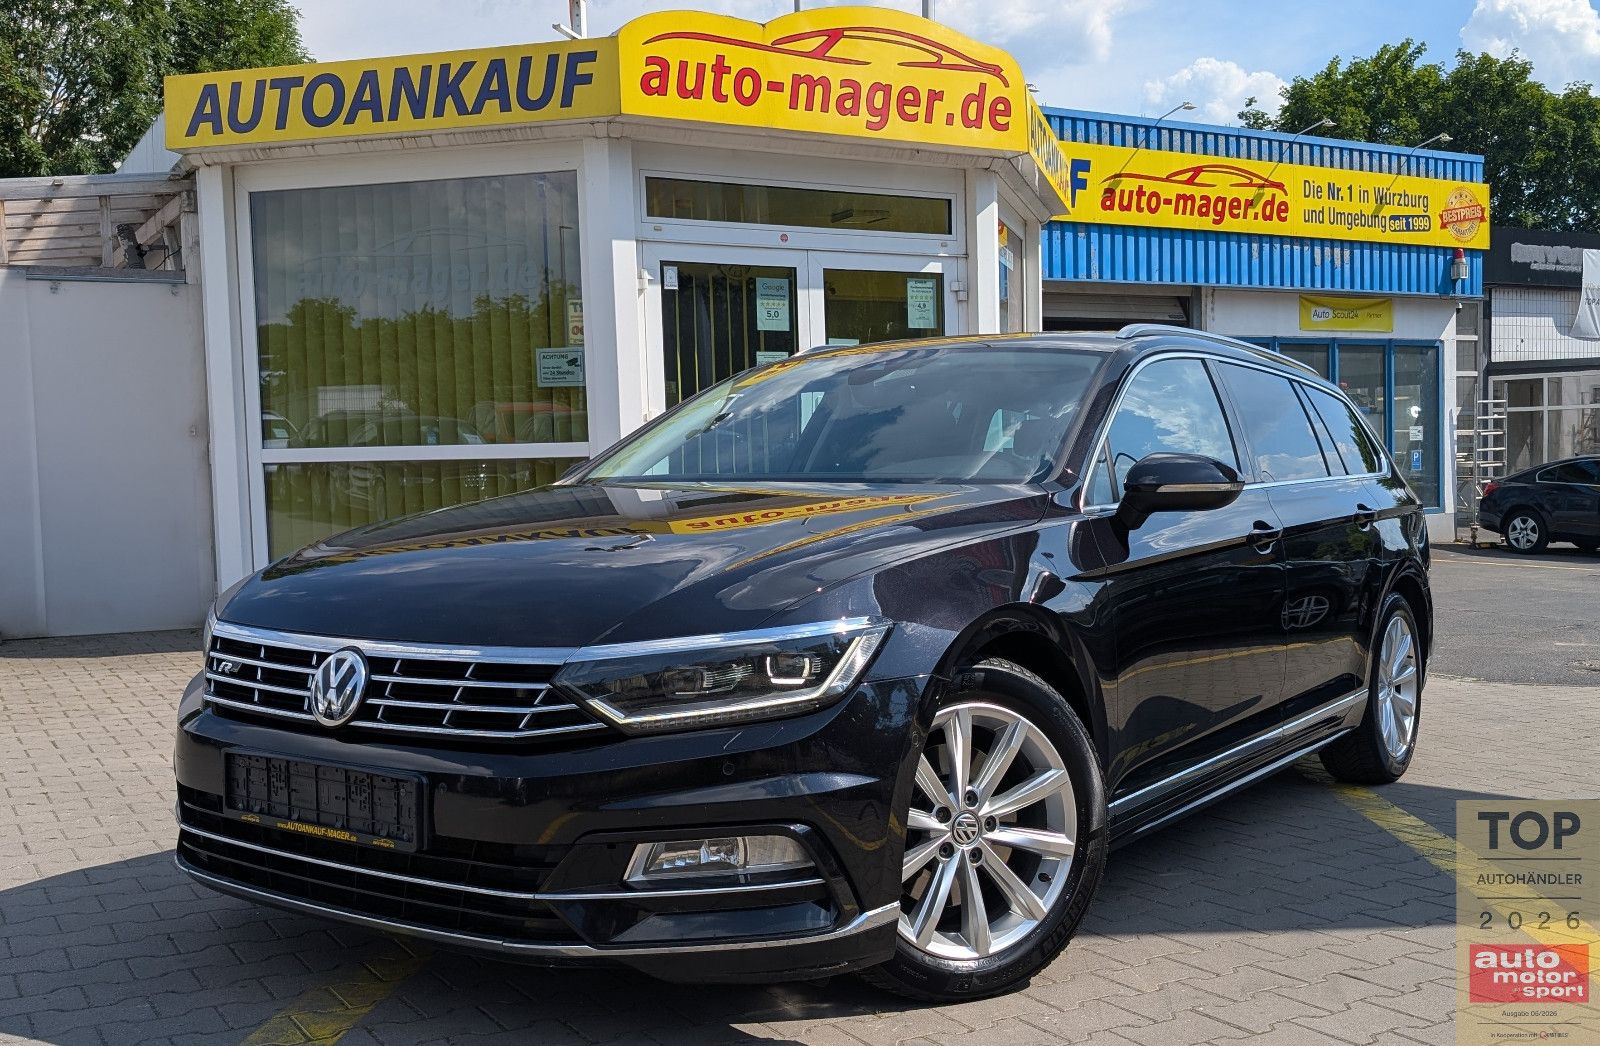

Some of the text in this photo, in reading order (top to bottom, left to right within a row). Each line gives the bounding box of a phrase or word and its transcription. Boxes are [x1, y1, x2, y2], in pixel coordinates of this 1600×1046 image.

[185, 51, 598, 138] AUTOANKAUF
[640, 54, 1012, 132] auto-mager.de
[1101, 184, 1289, 225] auto-mager.de
[1303, 179, 1429, 213] Die Nr. 1 in Würzburg
[1303, 206, 1430, 233] und Umgebung seit 1999
[1442, 205, 1482, 223] BESTPREIS
[761, 282, 785, 292] Google
[766, 310, 780, 319] 5,0
[1312, 309, 1330, 319] Auto
[1332, 309, 1360, 319] Scout24
